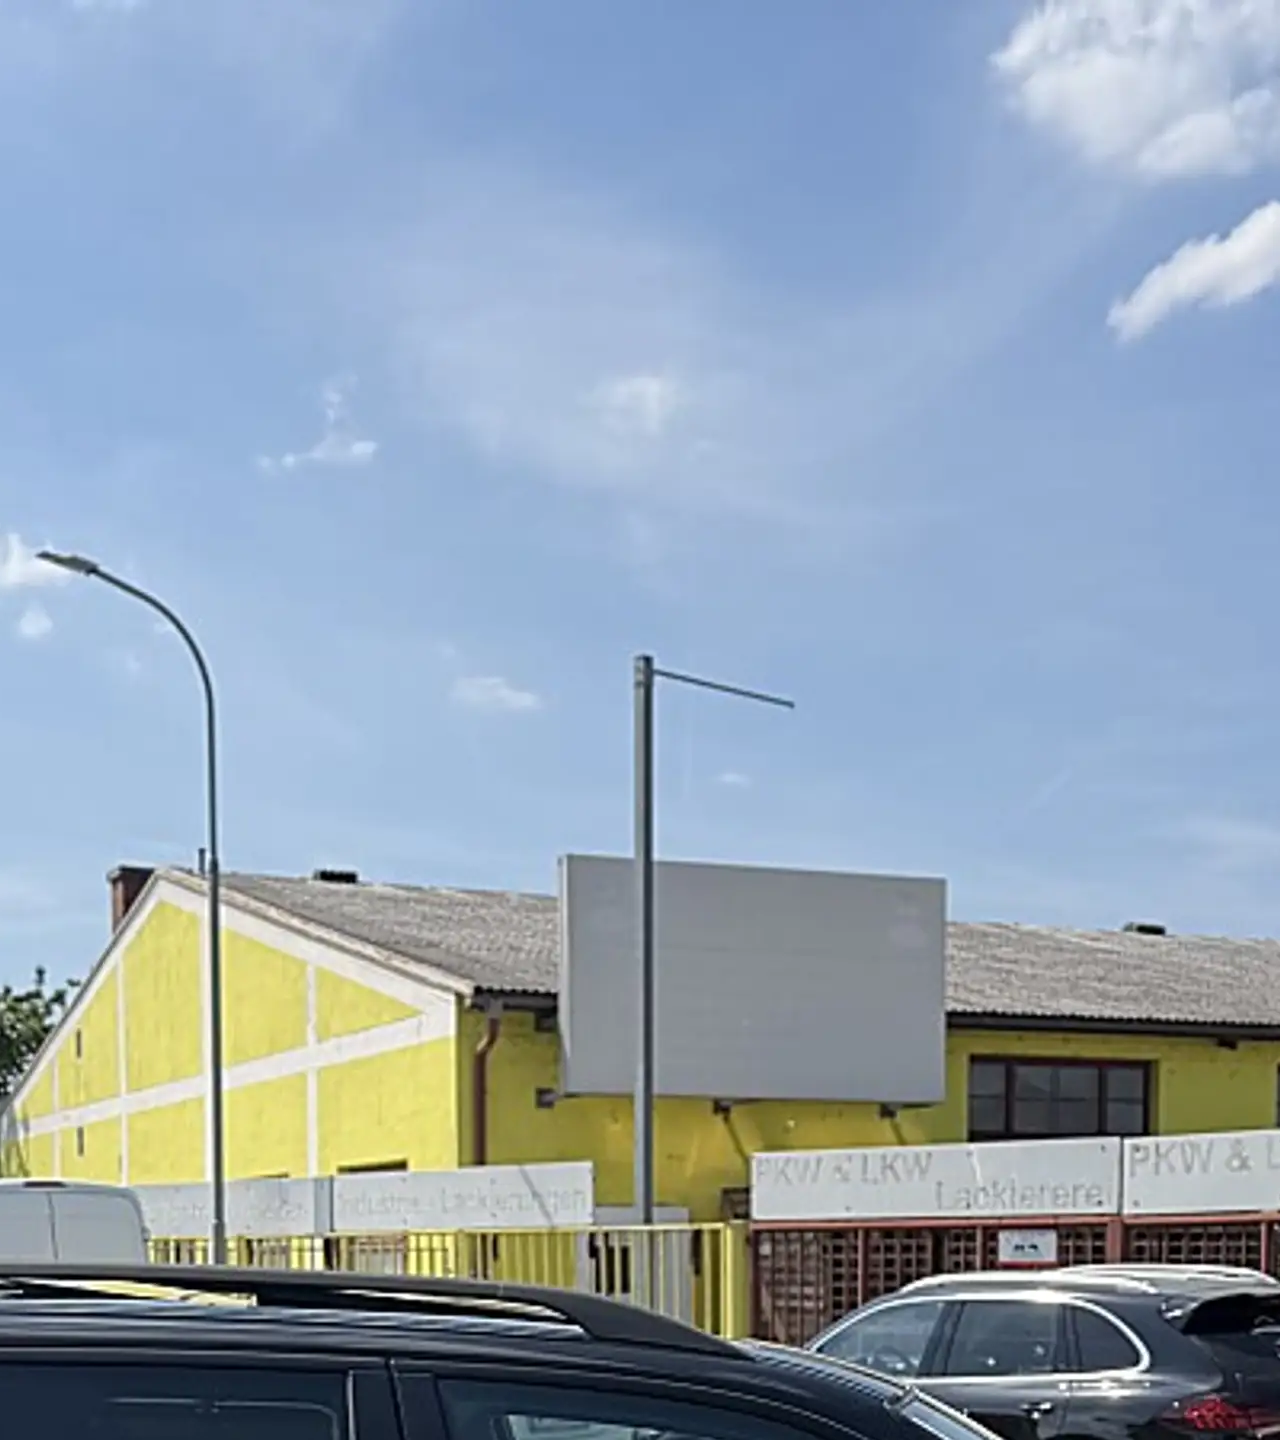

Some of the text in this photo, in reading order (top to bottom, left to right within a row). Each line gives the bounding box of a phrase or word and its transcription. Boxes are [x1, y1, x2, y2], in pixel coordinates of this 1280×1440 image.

[861, 1151, 933, 1185] LKW
[1129, 1139, 1214, 1178] PKW
[1224, 1137, 1253, 1173] &
